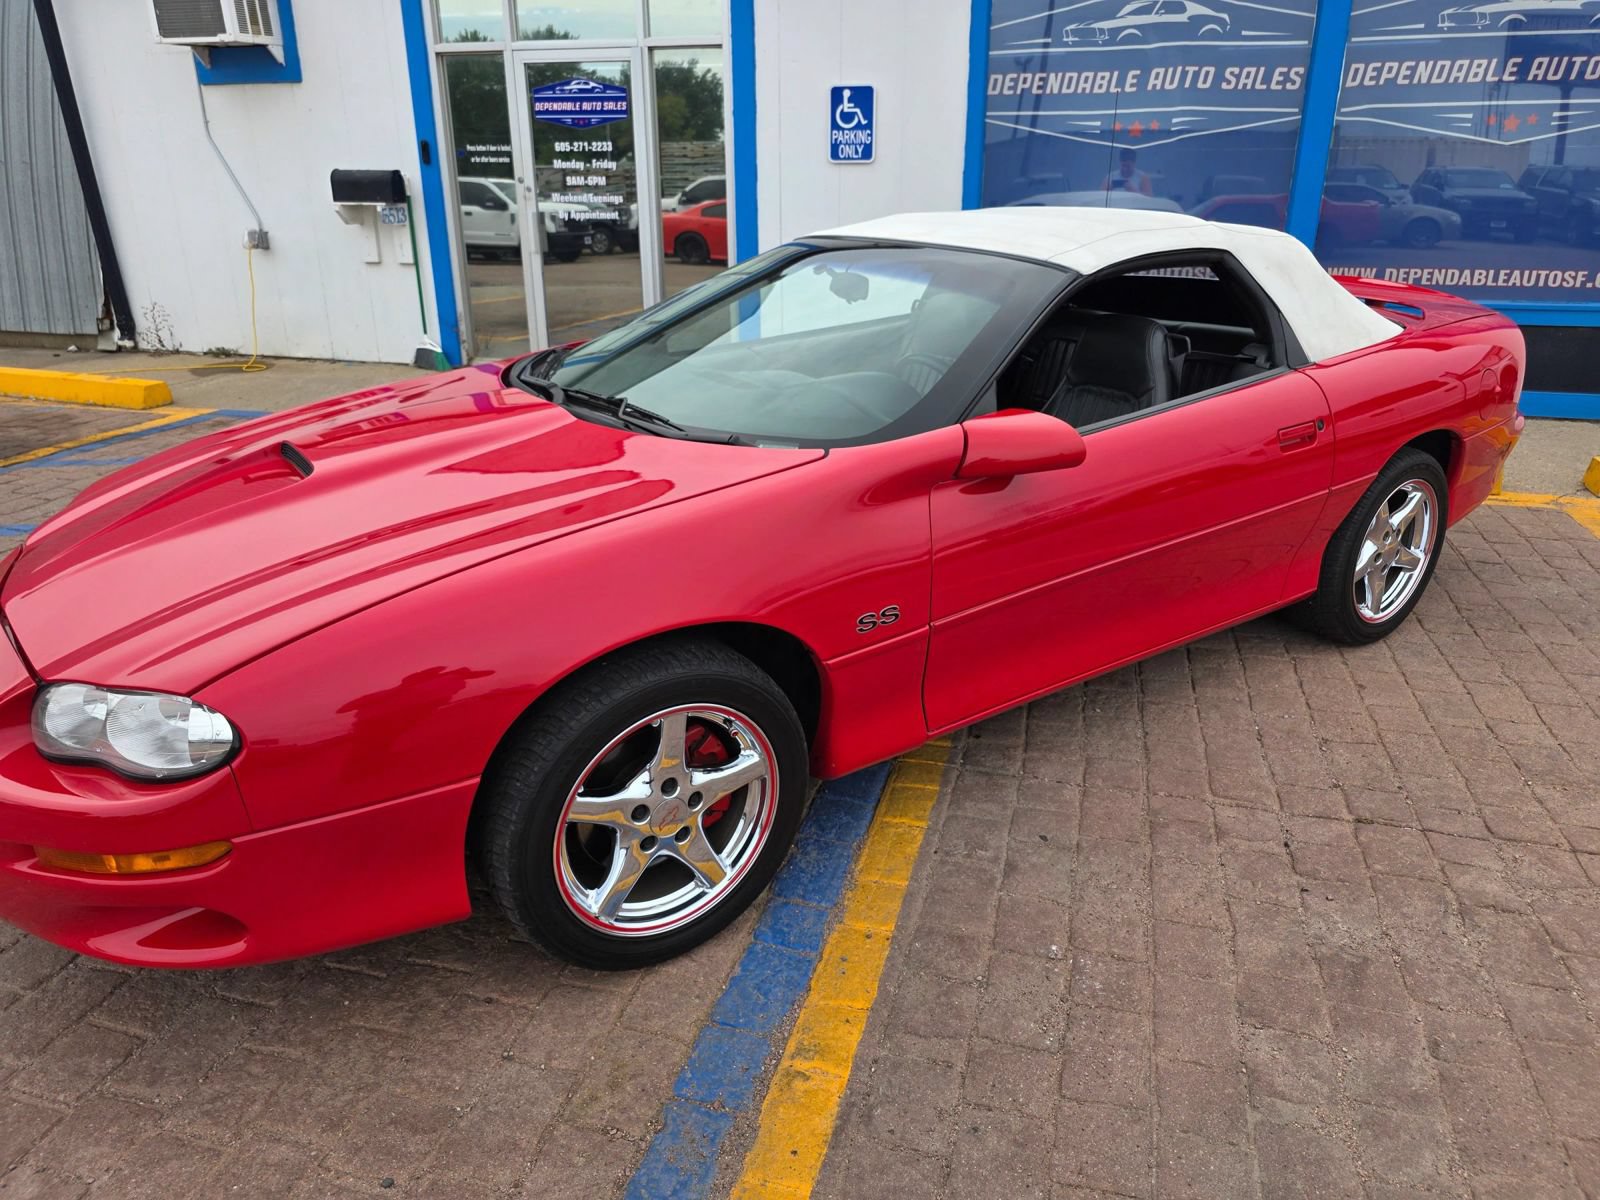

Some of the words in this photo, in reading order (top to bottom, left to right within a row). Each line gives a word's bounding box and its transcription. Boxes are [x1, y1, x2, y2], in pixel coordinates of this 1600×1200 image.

[1345, 58, 1523, 87] DEPENDABLE
[1527, 55, 1600, 81] AUTO
[987, 70, 1140, 95] DEPENDABLE
[1148, 66, 1215, 90] AUTO
[1221, 66, 1304, 90] SALES
[535, 102, 580, 111] DEPENDABLE
[582, 102, 602, 110] AUTO
[603, 101, 627, 110] SALES
[832, 129, 871, 144] PARKING
[554, 141, 613, 152] 605-271-2233
[839, 144, 864, 158] ONLY
[553, 159, 585, 171] Monday
[592, 159, 617, 171] Friday
[570, 210, 619, 221] Appointment
[856, 605, 900, 633] SS
